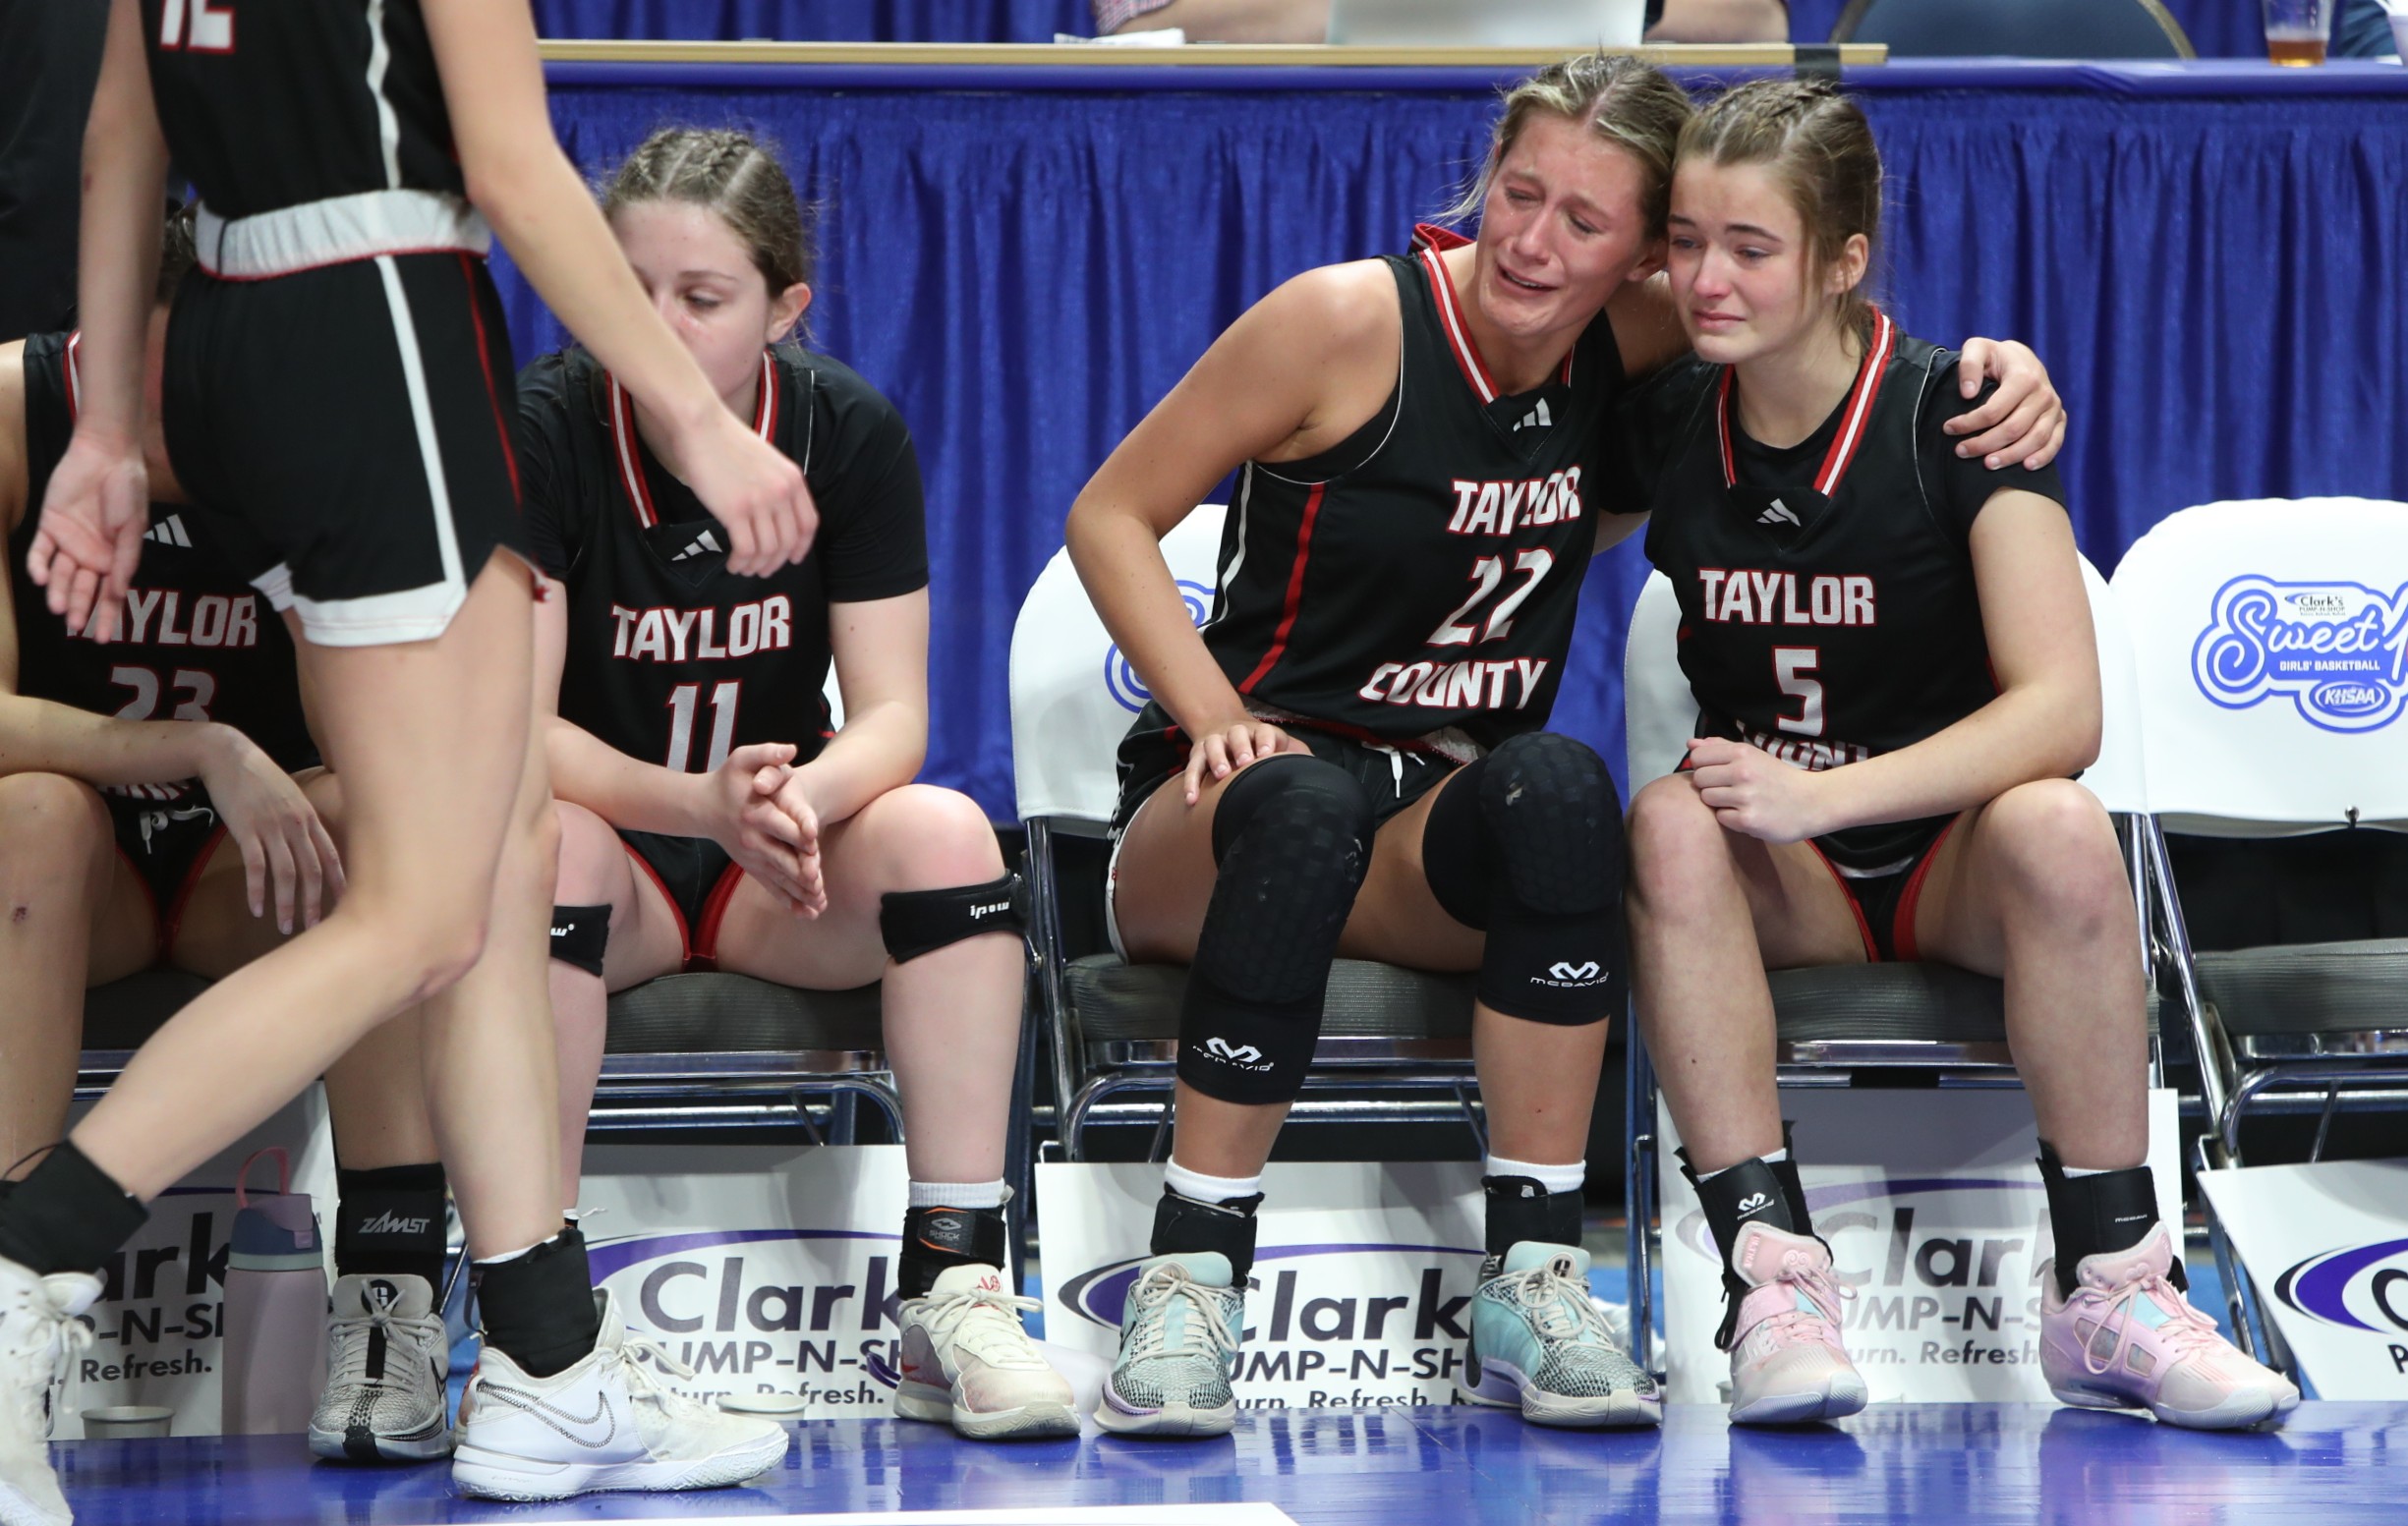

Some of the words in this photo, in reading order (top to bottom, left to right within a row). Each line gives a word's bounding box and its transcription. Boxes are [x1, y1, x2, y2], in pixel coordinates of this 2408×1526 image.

[1447, 464, 1582, 537] TAYLOR
[65, 588, 258, 648] AYLOR
[1425, 545, 1556, 647] 22
[1698, 567, 1876, 626] TAYLOR
[610, 593, 792, 663] TAYLOR
[2213, 594, 2379, 687] Sweet
[110, 663, 216, 722] 23
[1357, 656, 1550, 709] COUNTY
[1772, 645, 1825, 737] 5
[2279, 659, 2313, 672] GIRLS'
[2315, 659, 2380, 672] BASKETBALL
[664, 678, 743, 772] 11
[2323, 686, 2376, 706] KHSAA
[969, 904, 1010, 920] ipow
[358, 1210, 430, 1234] ZAMST
[81, 1348, 212, 1384] Refresh.
[757, 1381, 884, 1405] fresh.
